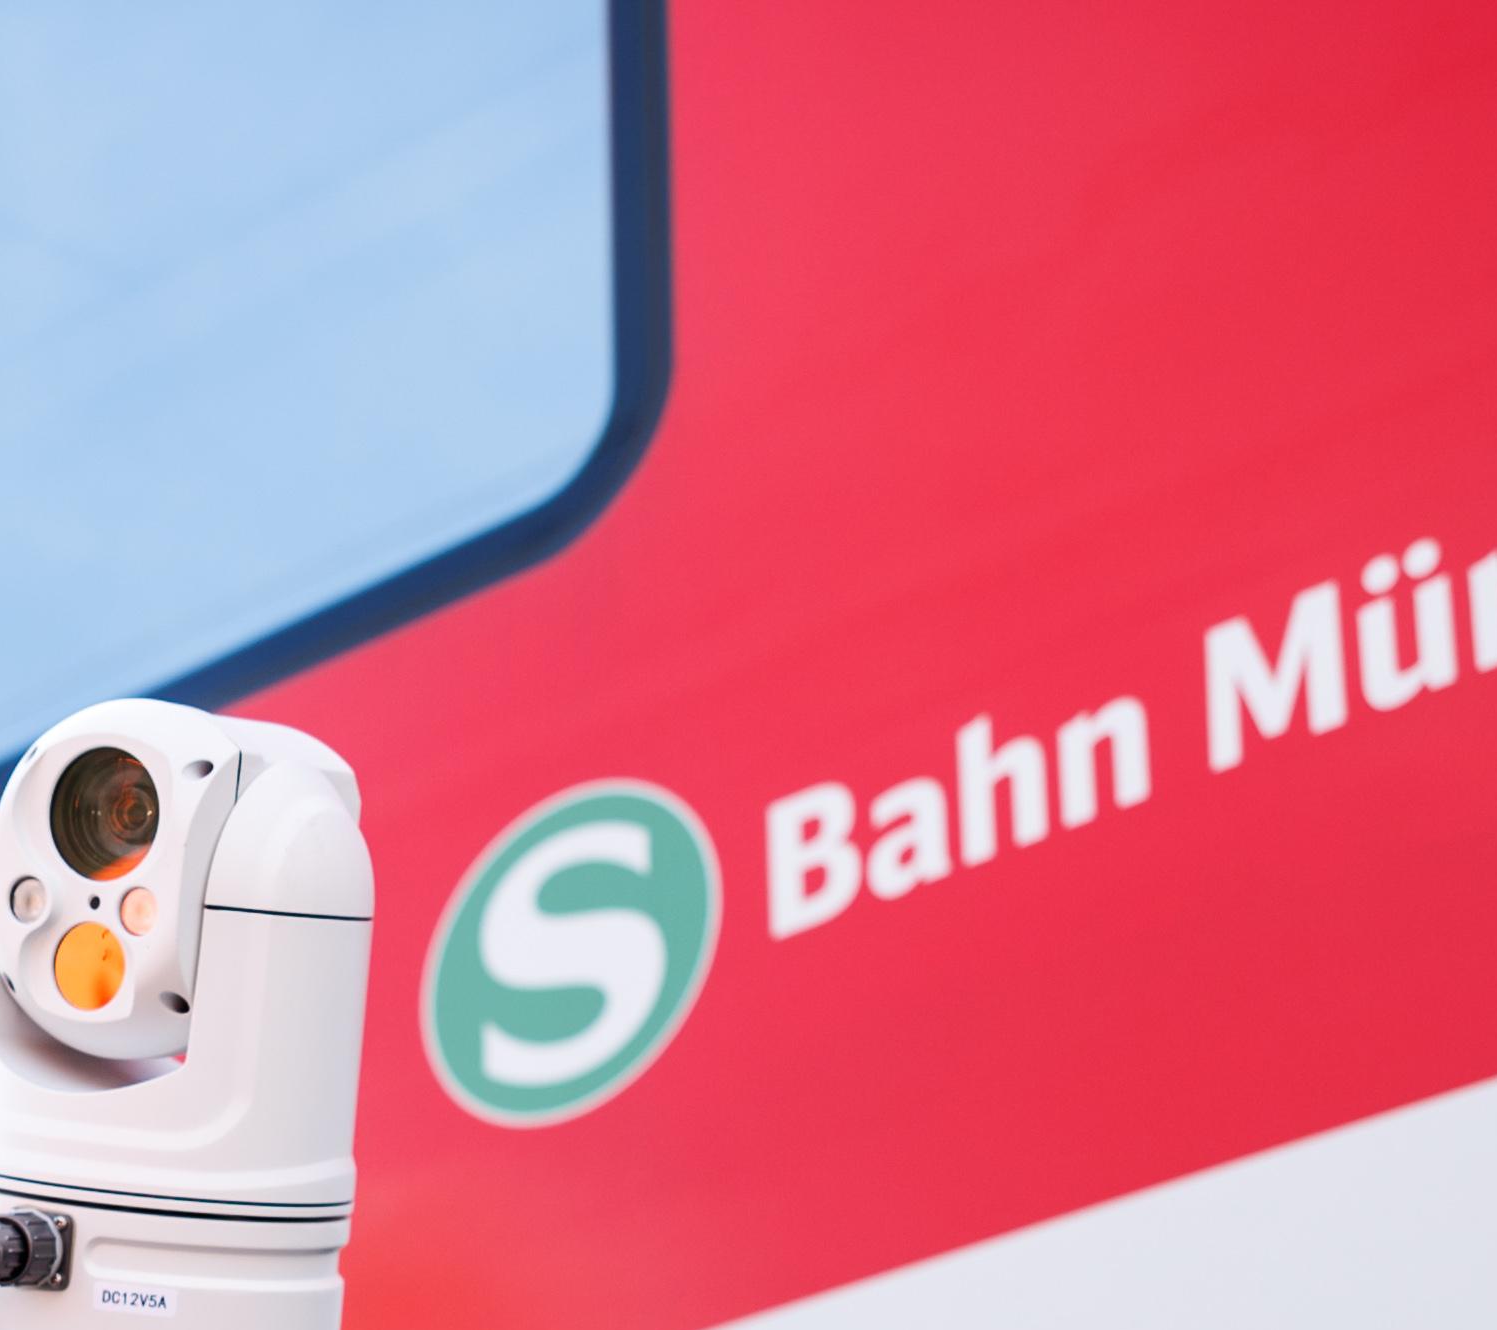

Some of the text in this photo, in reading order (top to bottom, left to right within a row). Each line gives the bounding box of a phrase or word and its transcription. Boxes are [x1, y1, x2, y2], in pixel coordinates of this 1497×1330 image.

[480, 822, 666, 1086] S
[764, 694, 1152, 941] Bahn
[101, 1289, 167, 1310] DC12V5A
